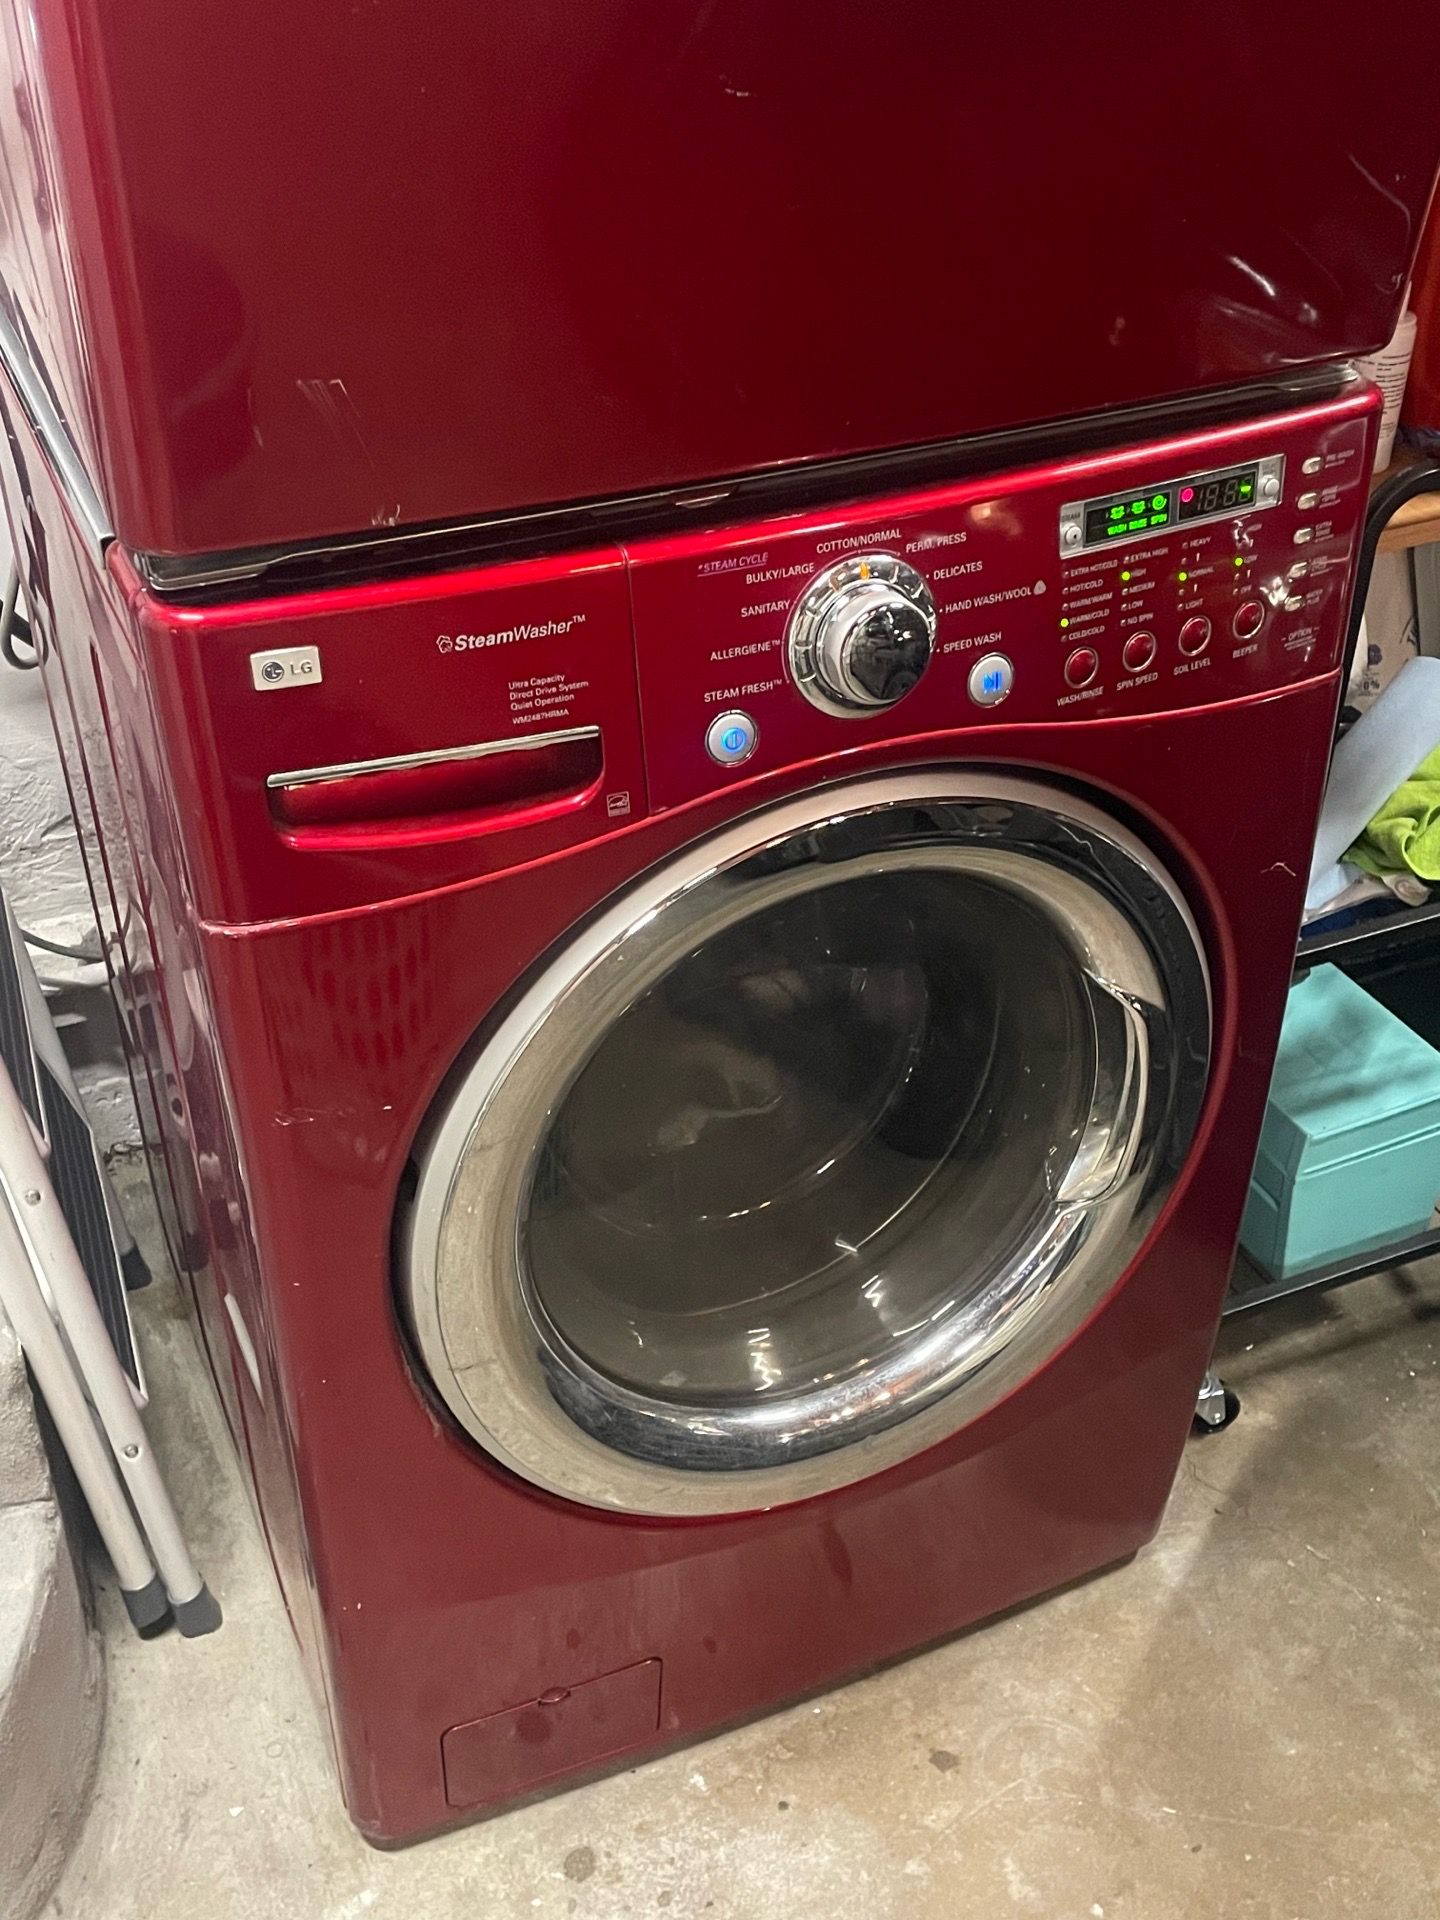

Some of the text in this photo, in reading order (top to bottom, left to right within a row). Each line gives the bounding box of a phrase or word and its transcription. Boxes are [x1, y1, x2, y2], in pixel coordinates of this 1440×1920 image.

[1150, 513, 1167, 525] SPIN
[816, 528, 902, 554] COTTON/NORMAL
[937, 532, 967, 547] PRESS
[1190, 536, 1211, 548] HEAVY
[739, 552, 768, 567] CYCLE
[1130, 547, 1169, 563] EXTRA HIGH
[746, 563, 815, 585] BULKY/LARGE
[933, 561, 983, 580] DELICATES
[1070, 560, 1118, 577] EXTRA HOT/COLD
[1188, 566, 1214, 579] NORMAL
[1070, 579, 1103, 592] HOT/COLD
[1128, 581, 1155, 594] MEDIUM
[945, 587, 1032, 614] HAND WASH/WOOL
[1069, 592, 1113, 608] WARM/WARM
[1127, 600, 1143, 611] LOW
[1185, 599, 1203, 610] LIGHT
[741, 600, 791, 618] SANITARY
[1069, 609, 1110, 625] WARM/COLD
[1127, 612, 1154, 626] NO SPIN
[1068, 625, 1105, 641] COLD/COLD
[1288, 627, 1313, 641] OPTION
[943, 632, 1002, 653] SPEED WASH
[1232, 643, 1259, 659] BEEPER
[289, 660, 313, 676] LG
[1173, 657, 1211, 676] SOIL LEVEL
[508, 674, 565, 690] Ultra Capacity
[1116, 672, 1158, 691] SPIN SPEED
[509, 680, 589, 701] Direct Drive System
[704, 687, 740, 703] STEAM
[1057, 686, 1104, 706] WASH/RINSE
[511, 693, 575, 711] Quiet Operation
